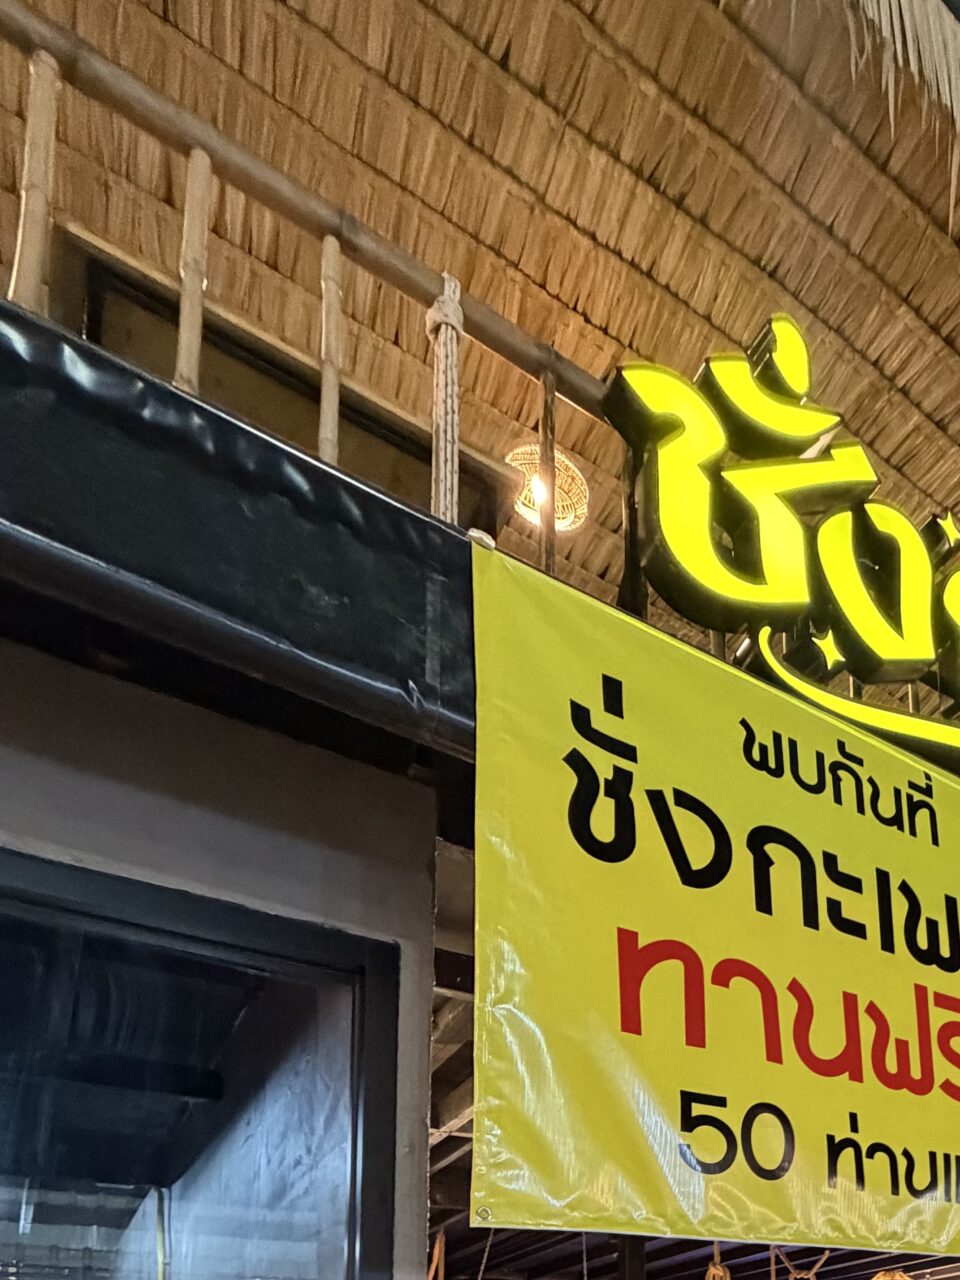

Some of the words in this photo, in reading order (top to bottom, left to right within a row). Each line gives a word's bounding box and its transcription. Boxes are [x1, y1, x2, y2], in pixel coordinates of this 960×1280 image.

[738, 717, 939, 847] พบกันที่
[678, 1089, 795, 1182] 50
